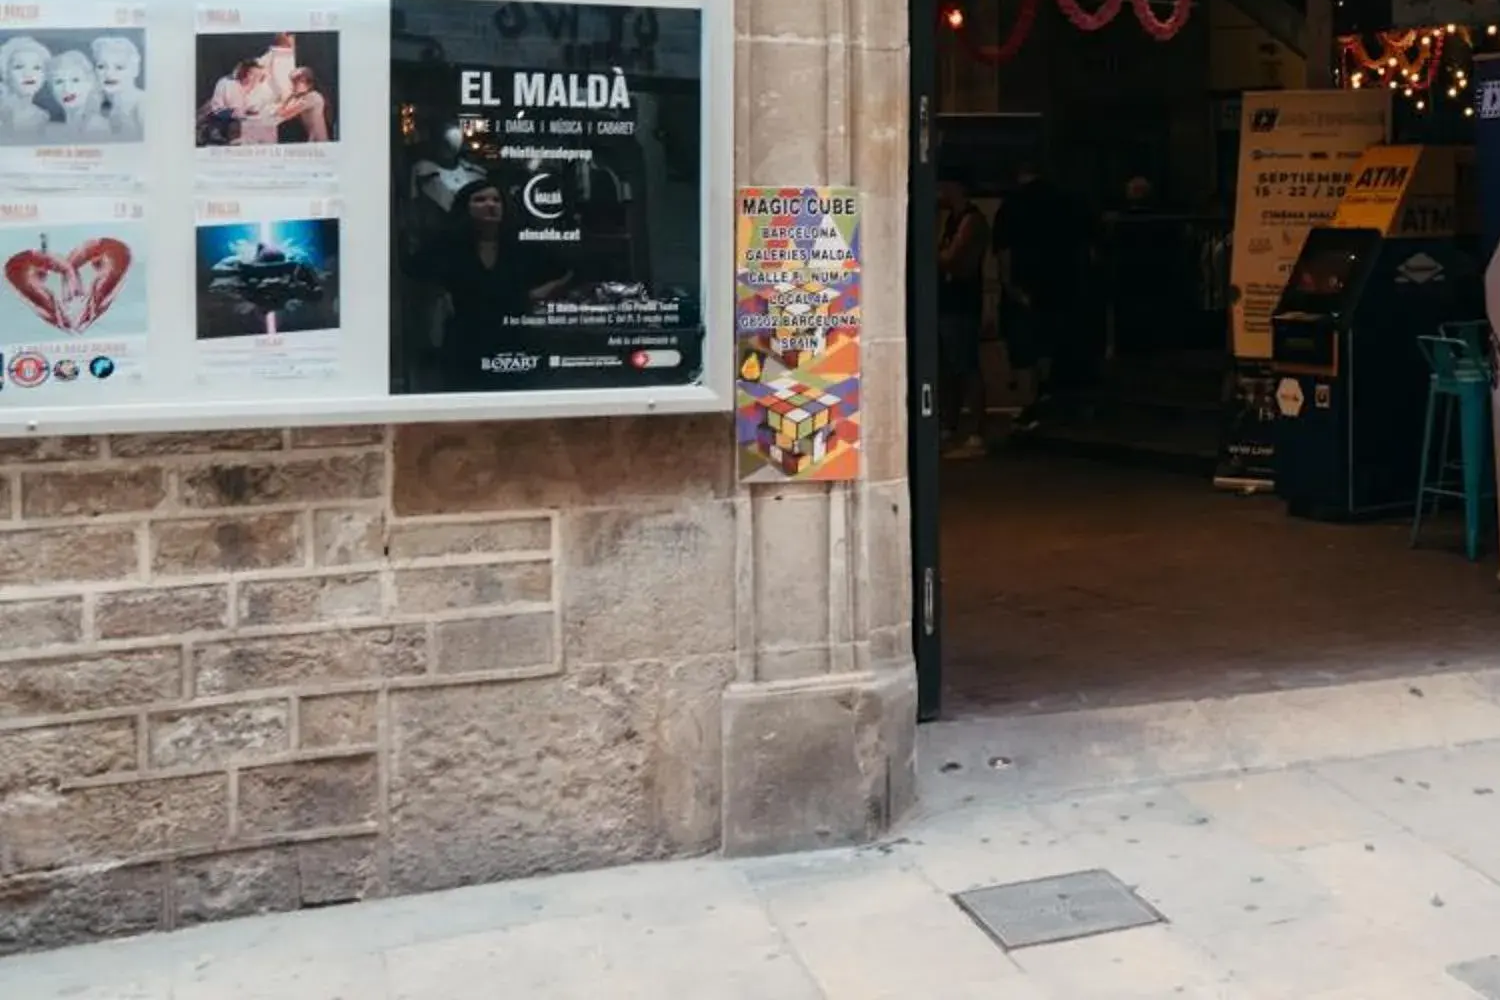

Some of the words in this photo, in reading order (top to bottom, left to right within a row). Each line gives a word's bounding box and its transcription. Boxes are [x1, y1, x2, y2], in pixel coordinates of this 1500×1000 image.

[461, 71, 501, 106] EL
[513, 67, 631, 109] MALDÀ
[1258, 171, 1354, 185] SEPTIEMBR
[1355, 166, 1410, 189] ATM
[743, 198, 800, 215] MAGIC
[807, 198, 855, 215] CUBE
[762, 227, 837, 240] BARCELONA
[746, 249, 807, 261] GALERIES
[749, 271, 790, 284] CALLE
[783, 316, 857, 328] BARCELONA
[781, 337, 819, 348] SPAIN
